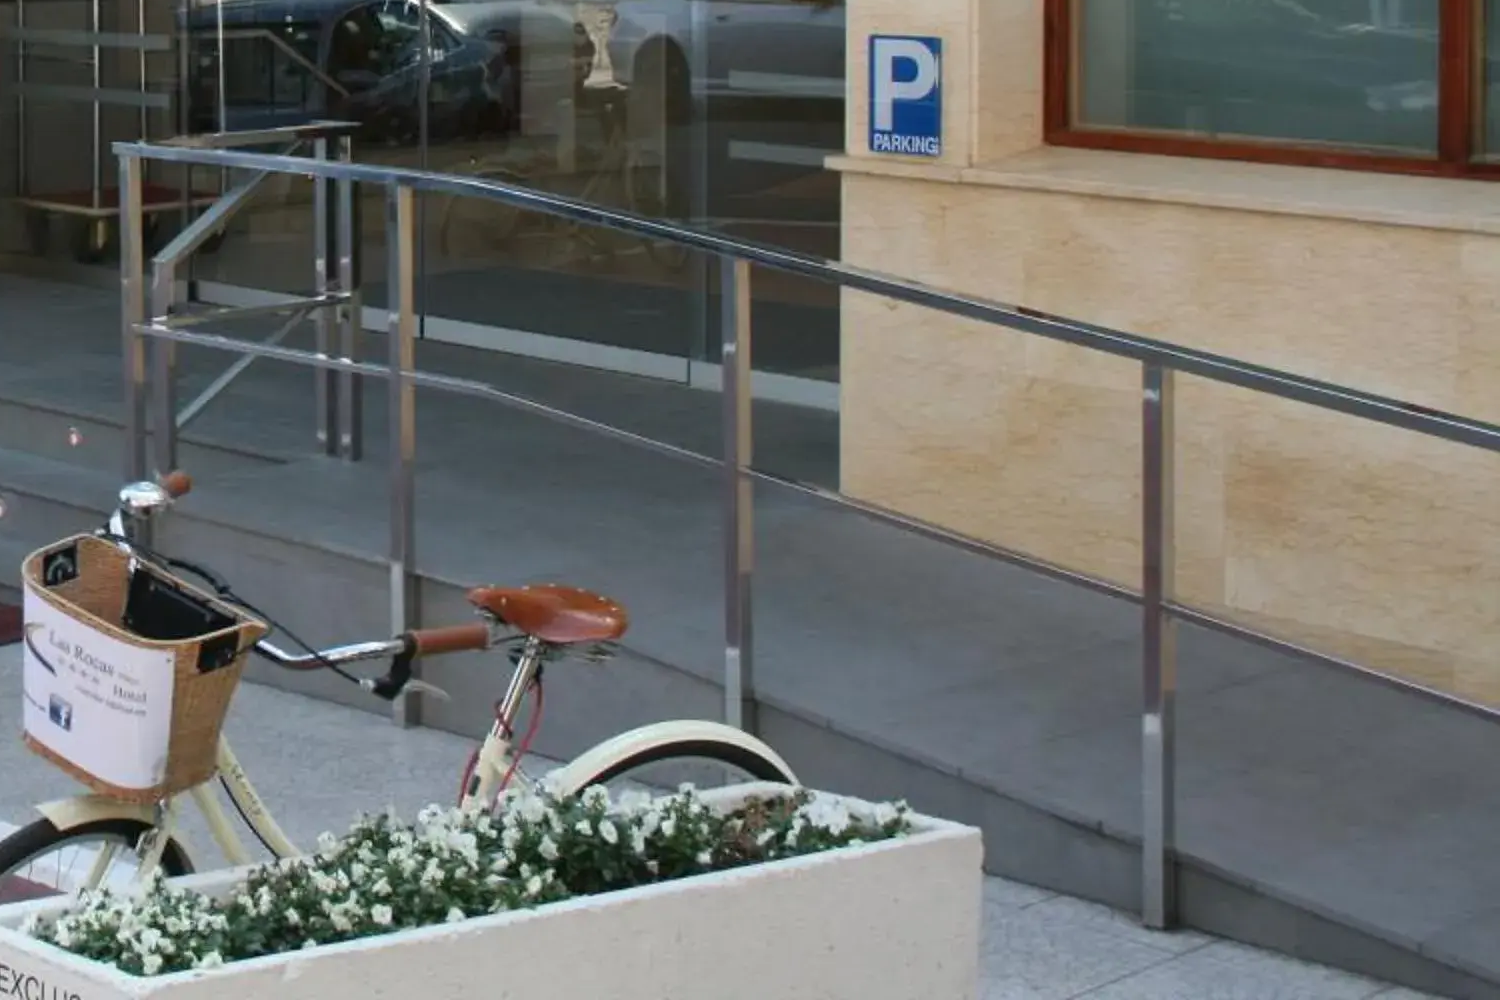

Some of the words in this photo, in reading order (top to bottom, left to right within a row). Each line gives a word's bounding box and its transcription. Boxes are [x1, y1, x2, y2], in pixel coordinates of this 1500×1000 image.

[874, 39, 935, 131] P
[873, 133, 938, 154] PARKING
[49, 629, 71, 655] Las
[74, 645, 114, 676] Rocas
[113, 684, 147, 703] Hotel
